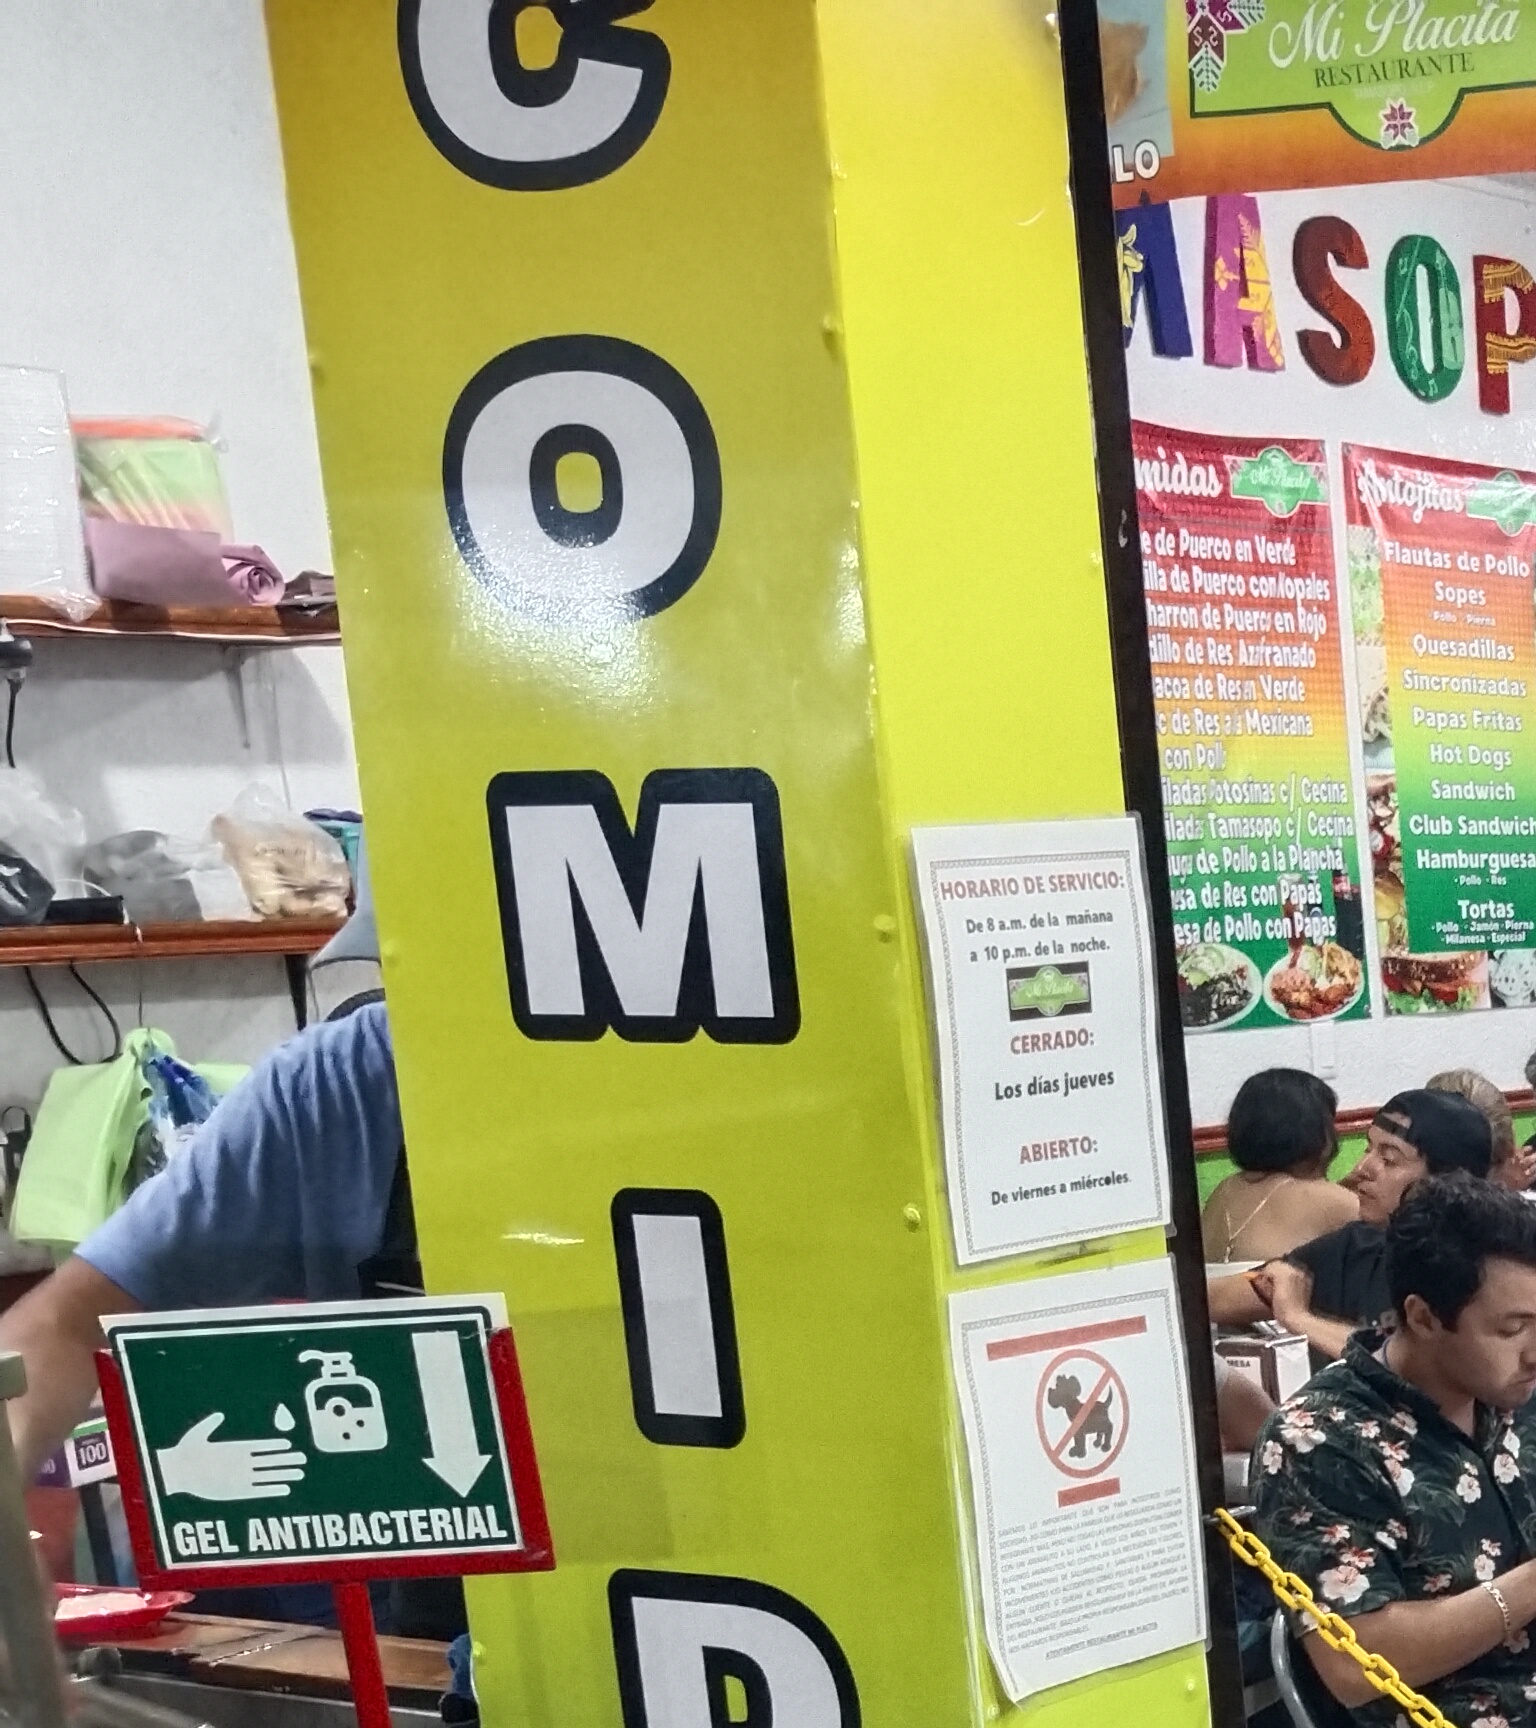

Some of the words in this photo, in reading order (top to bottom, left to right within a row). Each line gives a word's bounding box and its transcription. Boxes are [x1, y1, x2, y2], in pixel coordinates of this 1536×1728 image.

[1269, 4, 1344, 69] Mi
[1313, 52, 1475, 89] RESTAURANTE
[1155, 527, 1176, 556] de
[1178, 529, 1232, 561] Puerco
[1234, 540, 1252, 562] en
[1383, 541, 1451, 570] Flautas
[1457, 551, 1480, 572] de
[1485, 554, 1530, 578] Pollo
[1434, 580, 1487, 608] Sopes
[1413, 634, 1515, 661] Quesadillas
[1403, 669, 1527, 697] Sincronizadas
[1412, 706, 1467, 733] Papas
[1472, 710, 1523, 732] Fritas
[1430, 743, 1462, 764] Hot
[1468, 745, 1513, 771] Dogs
[1431, 779, 1516, 800] Sandwich
[1409, 814, 1453, 835] Club
[940, 877, 1020, 900] HORARIO
[1024, 876, 1046, 895] DE
[1048, 871, 1126, 893] SERVICIO:
[966, 919, 984, 934] De
[986, 918, 996, 933] 8
[998, 915, 1027, 932] a.m.
[1030, 914, 1046, 929] de
[1048, 912, 1060, 928] la
[1065, 909, 1114, 927] mañana
[1457, 900, 1515, 920] Tortas
[970, 952, 978, 962] a
[984, 946, 1000, 962] 10
[1003, 943, 1032, 964] p.m.
[1035, 942, 1051, 957] de
[1052, 940, 1065, 955] la
[1070, 937, 1111, 954] noche.
[1010, 1028, 1096, 1055] CERRADO:
[994, 1080, 1023, 1101] Los
[1027, 1075, 1060, 1096] días
[1063, 1069, 1115, 1096] jueves
[1019, 1135, 1099, 1165] ABIERTO:
[991, 1189, 1009, 1206] De
[1011, 1182, 1057, 1202] viernes
[1059, 1184, 1068, 1195] a
[78, 1441, 108, 1466] 100
[173, 1519, 240, 1557] GEL
[247, 1504, 508, 1553] ANTIBACTERIAL
